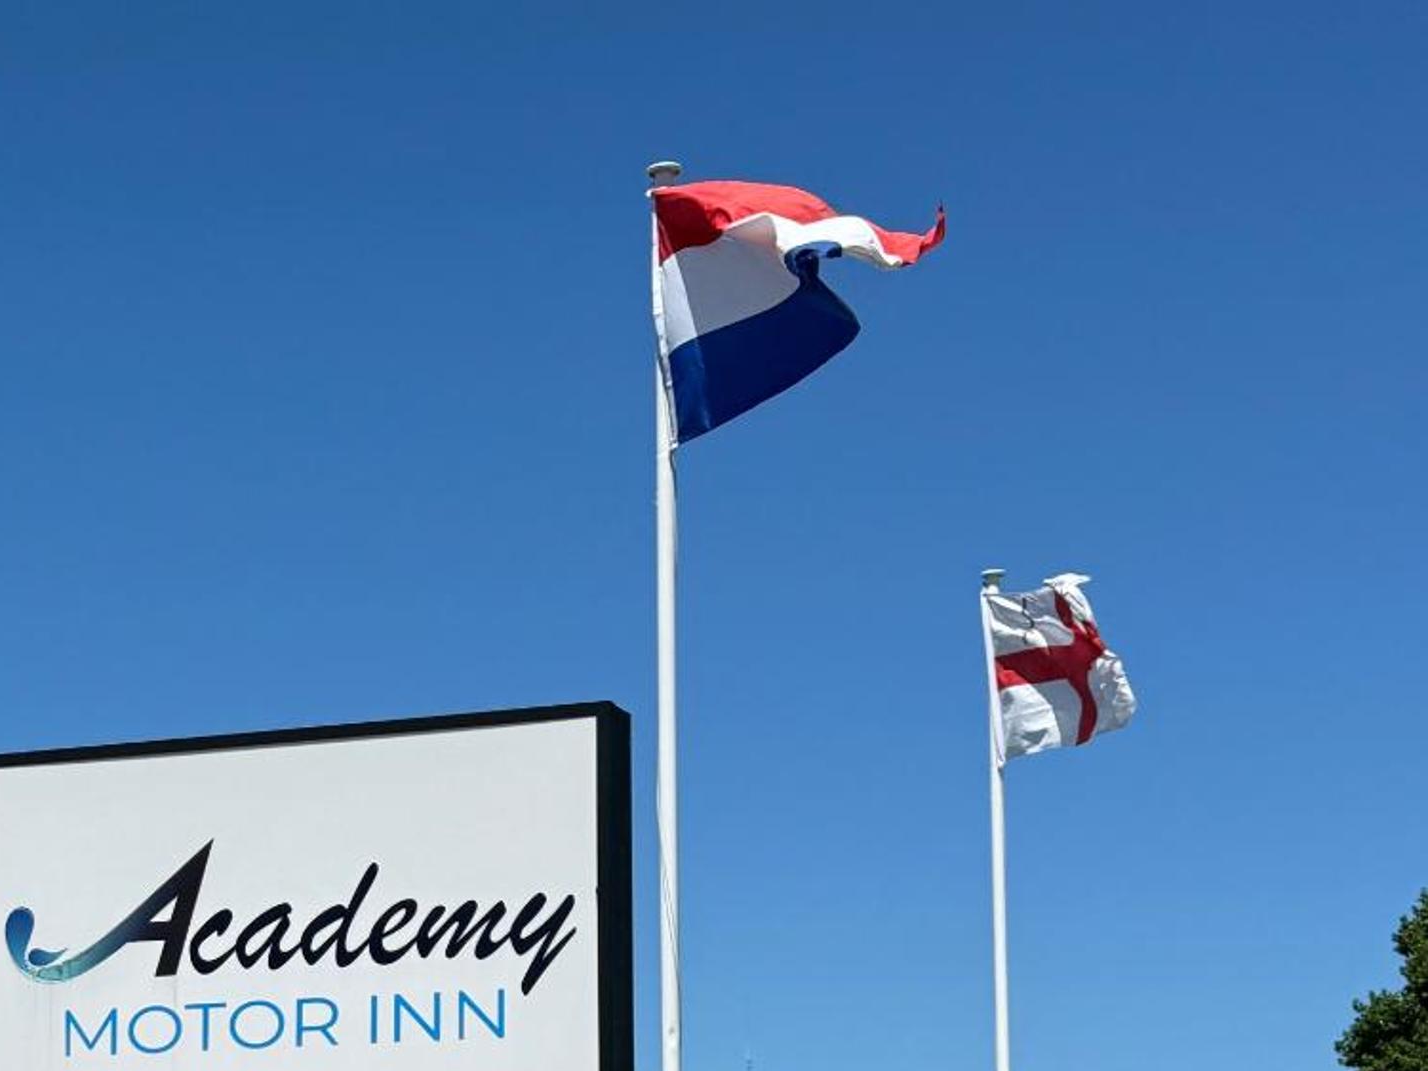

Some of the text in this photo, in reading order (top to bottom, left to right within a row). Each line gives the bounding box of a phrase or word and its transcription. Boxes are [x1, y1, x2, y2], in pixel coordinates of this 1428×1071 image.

[5, 838, 577, 996] Academy
[63, 988, 507, 1058] MOTOR INN
